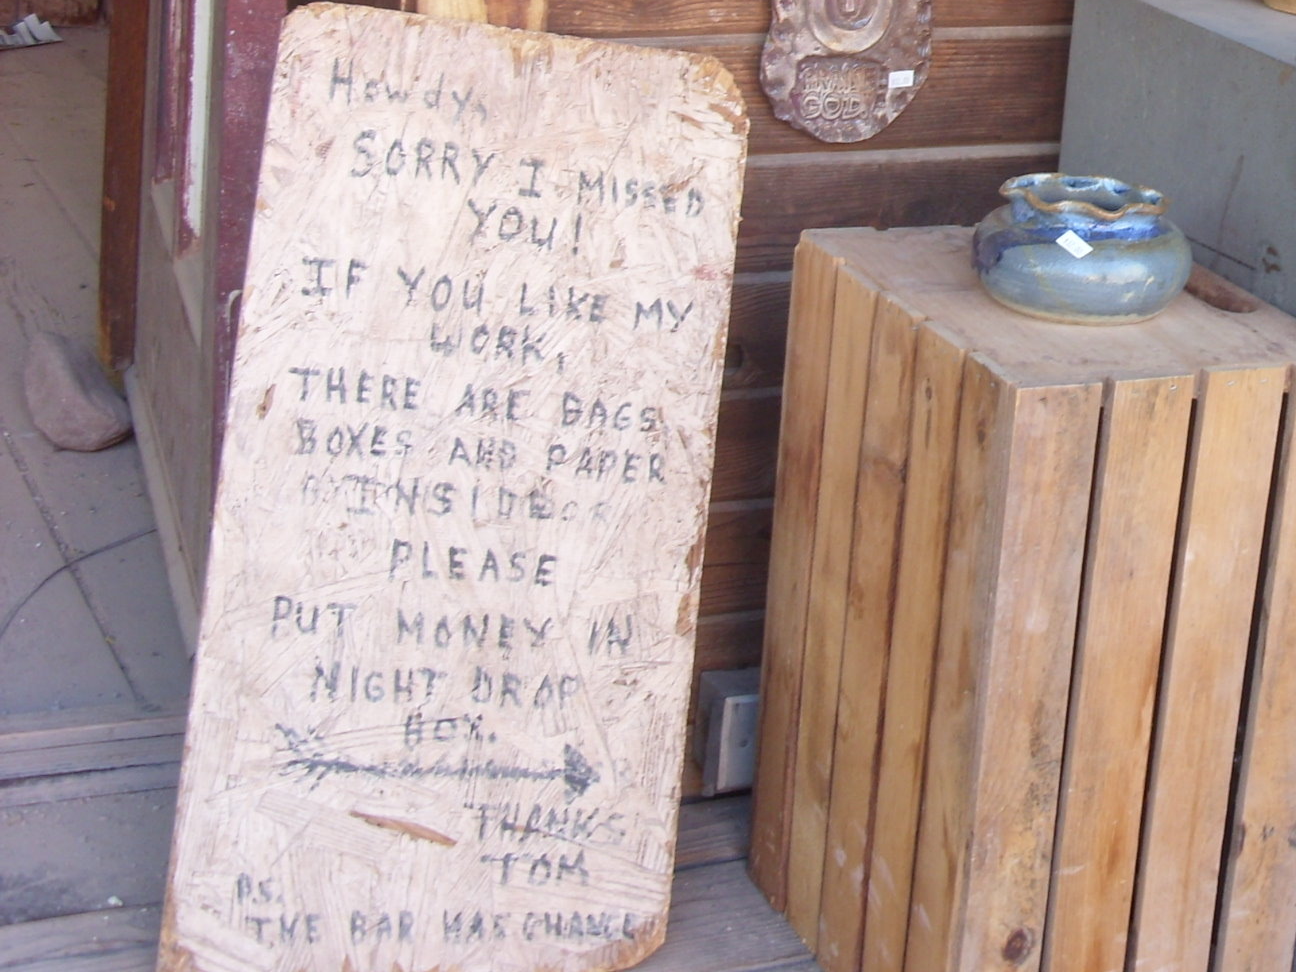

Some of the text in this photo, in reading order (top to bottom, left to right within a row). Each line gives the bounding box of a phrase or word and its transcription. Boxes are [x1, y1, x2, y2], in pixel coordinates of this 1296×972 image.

[351, 129, 707, 219] SORRY I MISSED
[465, 198, 584, 256] YOU!
[300, 256, 695, 334] IF YOU LIKE MY
[428, 322, 566, 374] WORK,
[288, 366, 658, 433] THERE ARE BAGS
[296, 417, 668, 485] BOXES AND PAPER
[388, 538, 559, 588] PLEASE
[271, 594, 636, 656] PUT MONEY IN
[310, 661, 584, 709] NIGHT DROP
[480, 849, 591, 887] TOM
[245, 912, 323, 948] THE
[349, 908, 418, 945] BAR
